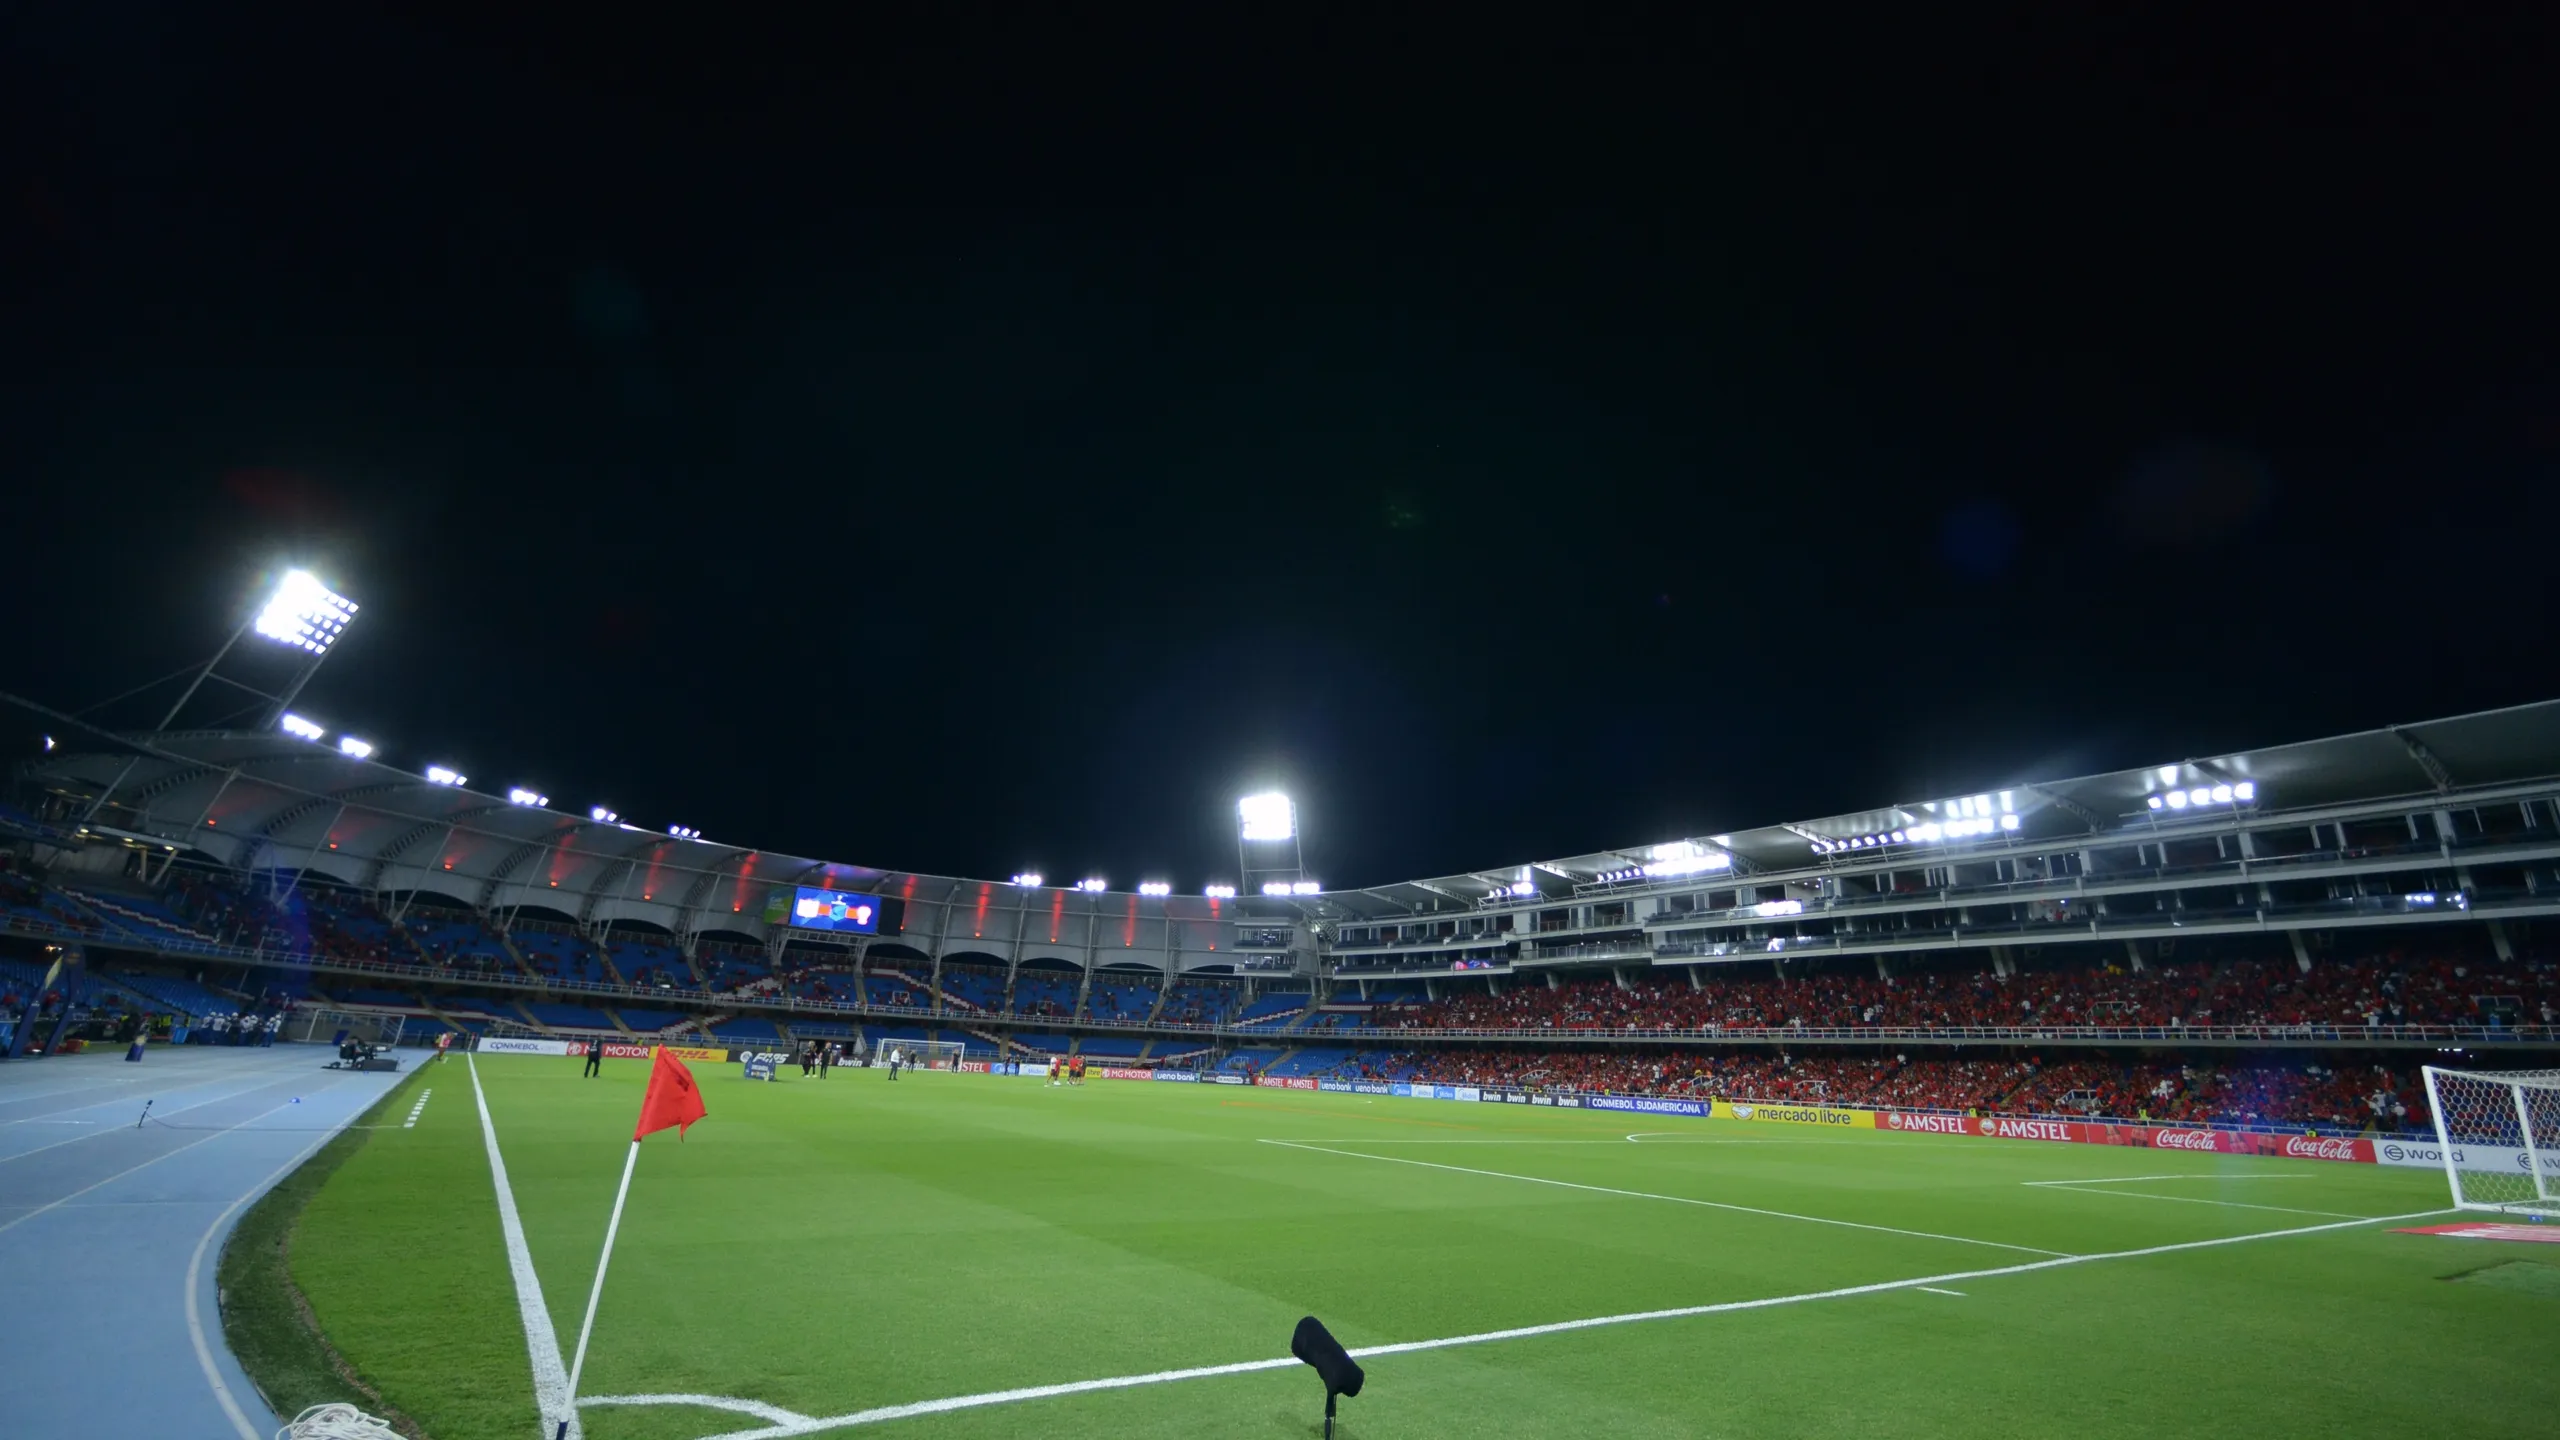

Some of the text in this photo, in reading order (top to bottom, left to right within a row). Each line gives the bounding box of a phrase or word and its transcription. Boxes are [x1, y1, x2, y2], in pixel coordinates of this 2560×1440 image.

[605, 1046, 649, 1057] MOTOR
[838, 1057, 863, 1067] bwin
[1111, 1070, 1124, 1078] MG
[1125, 1070, 1152, 1079] MOTOR
[1157, 1072, 1195, 1081] ueno bank
[1263, 1077, 1284, 1087] AMSTEL
[1293, 1079, 1314, 1089] AMSTEL
[1321, 1081, 1352, 1091] ueno bank
[1355, 1083, 1388, 1094] ueno bank
[1483, 1091, 1501, 1102] bwin
[1507, 1092, 1526, 1103] bwin
[1532, 1094, 1552, 1105] bwin
[1558, 1096, 1579, 1107] bwin
[1592, 1097, 1701, 1114] CONMEBOL SUDAMERICANA
[1757, 1107, 1851, 1125] mercado libre
[1904, 1115, 1967, 1134] AMSTEL
[1999, 1120, 2071, 1141] AMSTEL
[2156, 1128, 2217, 1151] Coca-Cola
[2286, 1136, 2356, 1160] Coca-Cola
[2406, 1147, 2465, 1163] word
